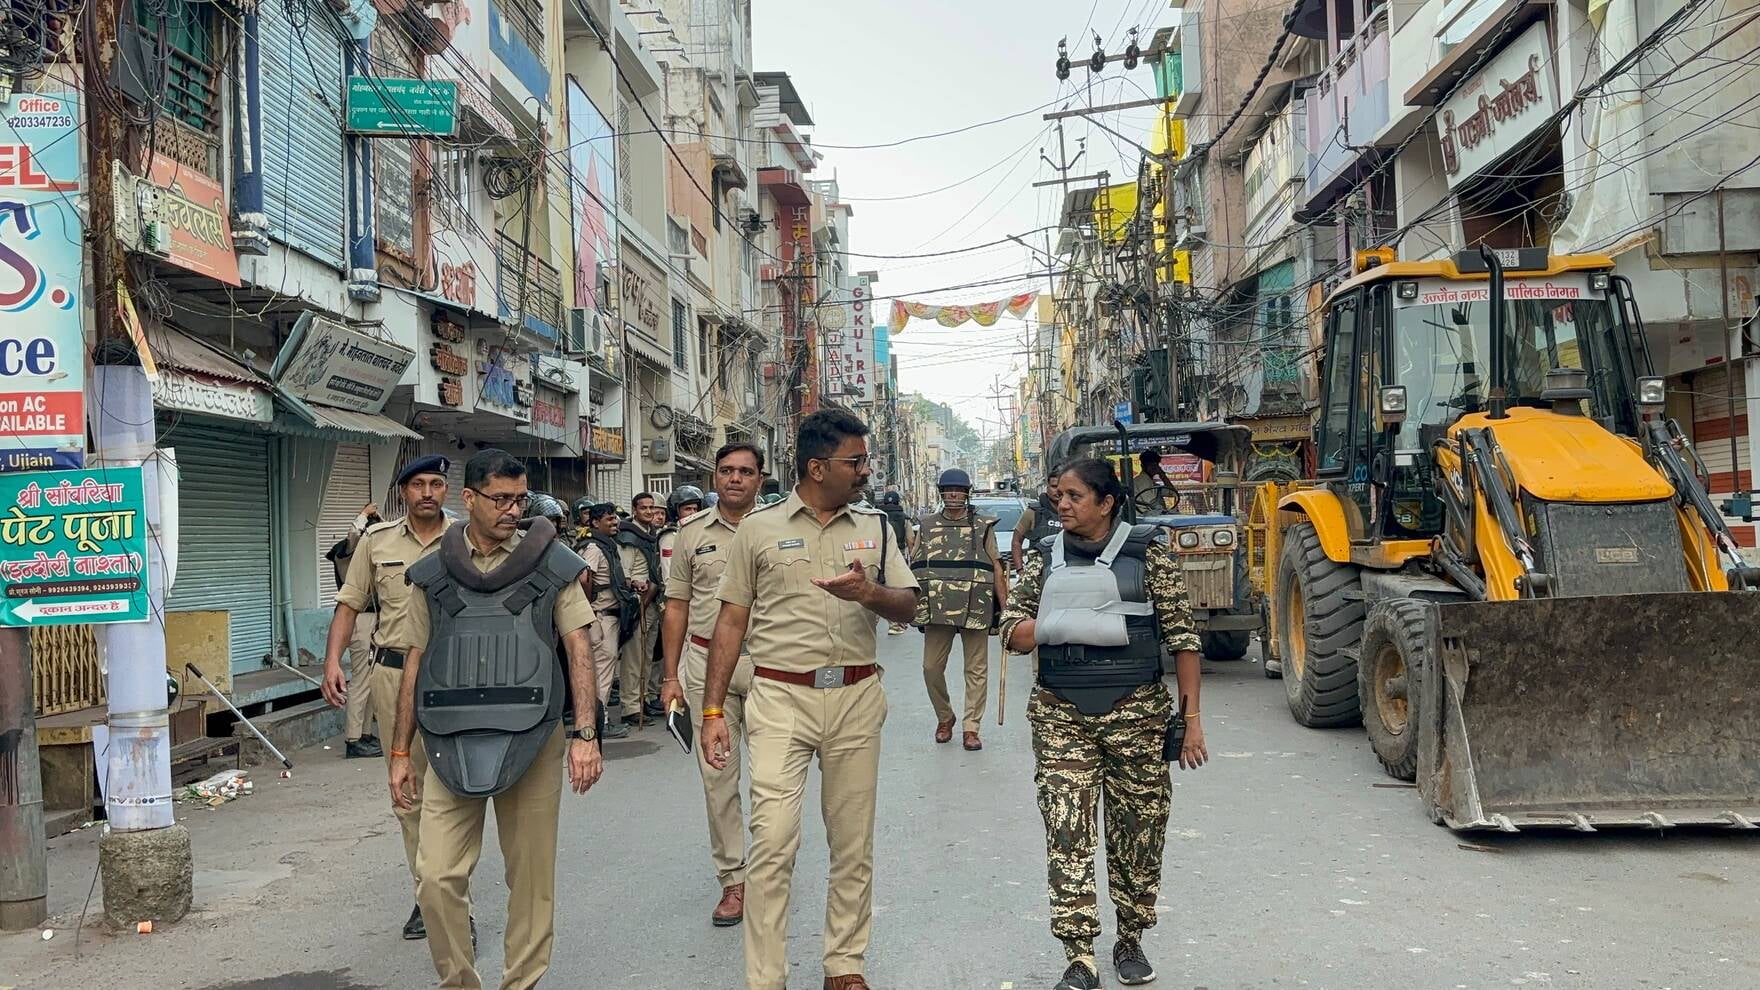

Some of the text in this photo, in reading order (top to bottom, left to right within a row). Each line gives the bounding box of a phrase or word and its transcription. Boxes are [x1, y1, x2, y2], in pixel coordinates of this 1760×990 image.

[20, 99, 59, 112] Office
[1460, 288, 1488, 301] नगर
[1545, 282, 1580, 299] निगम
[853, 287, 864, 353] GOKUL
[22, 395, 46, 412] AC
[0, 413, 66, 432] AILABLE
[9, 453, 54, 471] Ujjain
[18, 482, 41, 508] श्री
[1, 507, 136, 552] पेट पूजा
[111, 601, 120, 611] है
